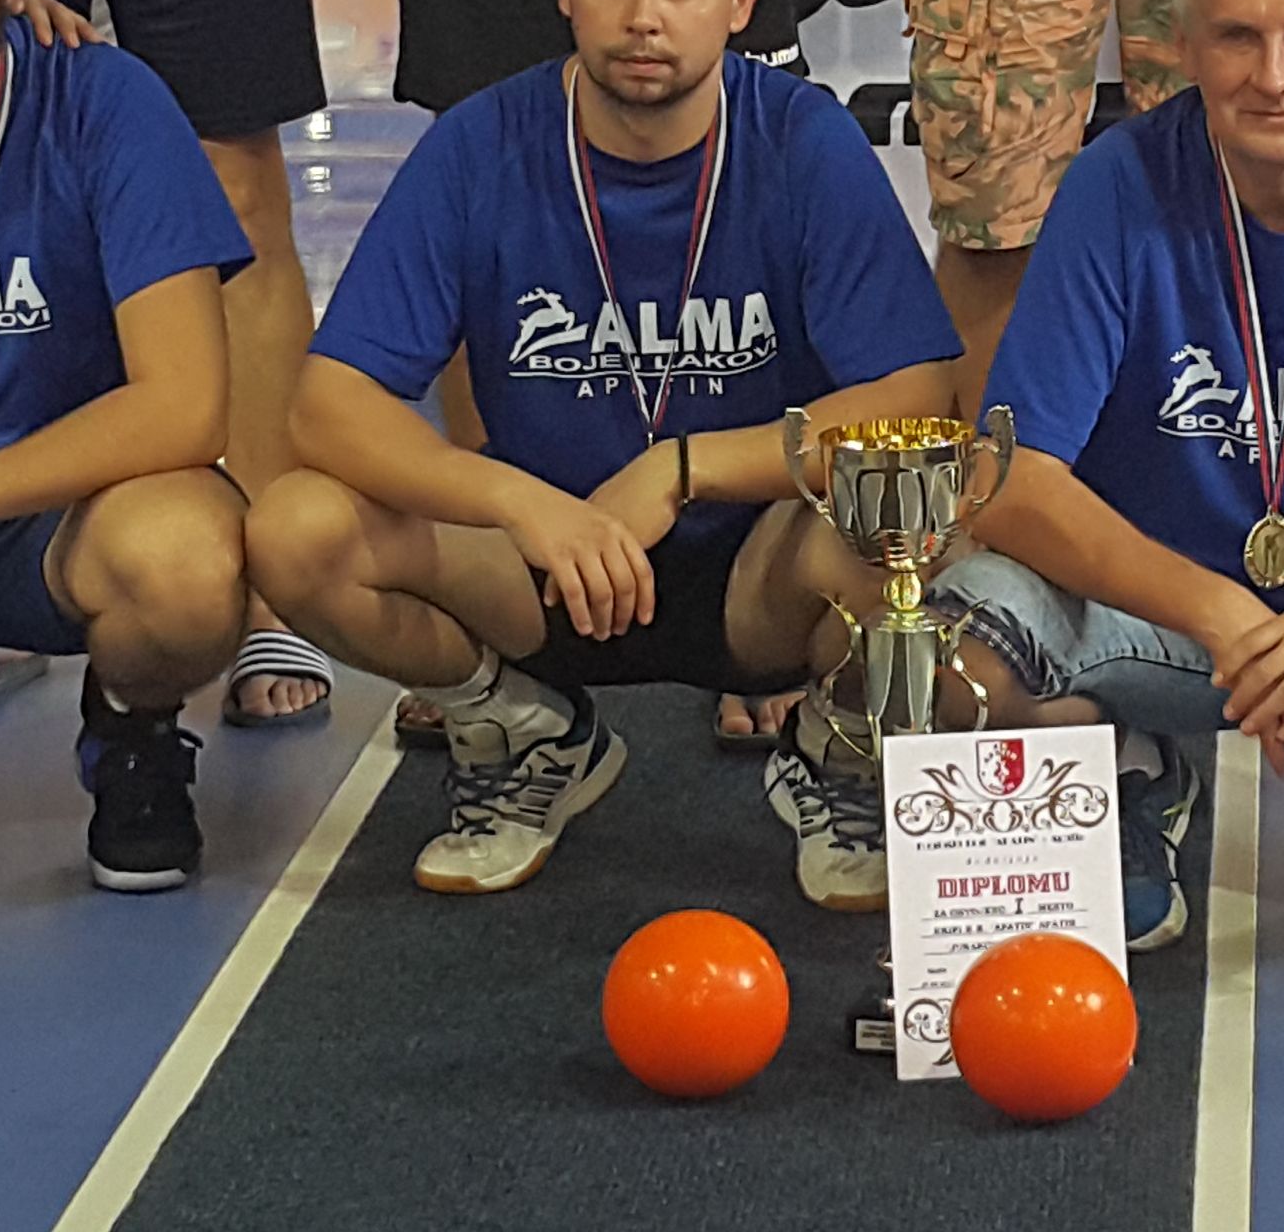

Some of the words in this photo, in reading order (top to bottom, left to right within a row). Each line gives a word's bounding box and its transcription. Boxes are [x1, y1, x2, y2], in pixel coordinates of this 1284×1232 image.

[591, 292, 776, 354] ALMA
[528, 353, 621, 372] BOJE
[937, 871, 1070, 899] DIPLOMU
